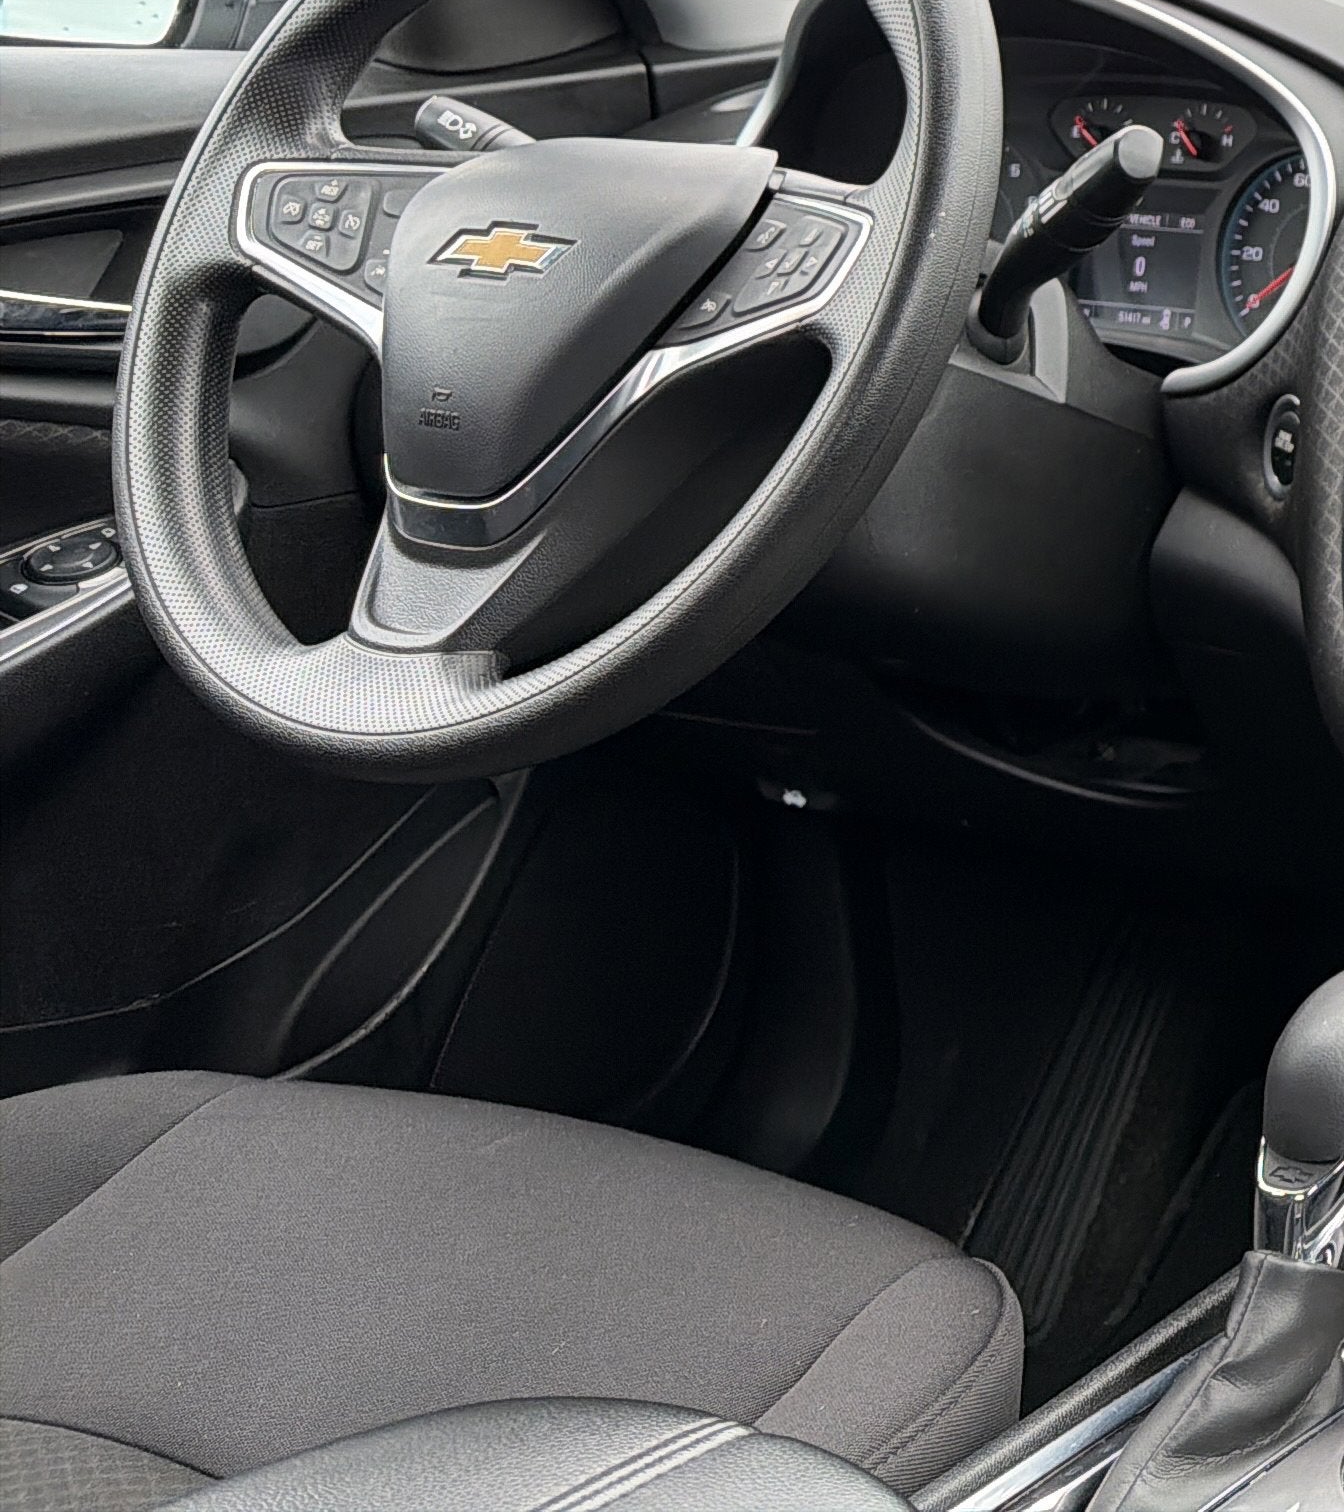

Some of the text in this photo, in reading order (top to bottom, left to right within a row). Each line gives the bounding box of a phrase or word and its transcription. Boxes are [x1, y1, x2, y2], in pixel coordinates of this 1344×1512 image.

[1169, 131, 1180, 144] C
[1222, 134, 1233, 147] H
[1293, 173, 1311, 187] 60
[1259, 198, 1280, 212] 40
[1131, 234, 1156, 247] Speed
[1241, 246, 1264, 261] 20
[1133, 256, 1147, 276] 0
[1129, 280, 1148, 293] MPH
[417, 408, 461, 431] AIRBAG
